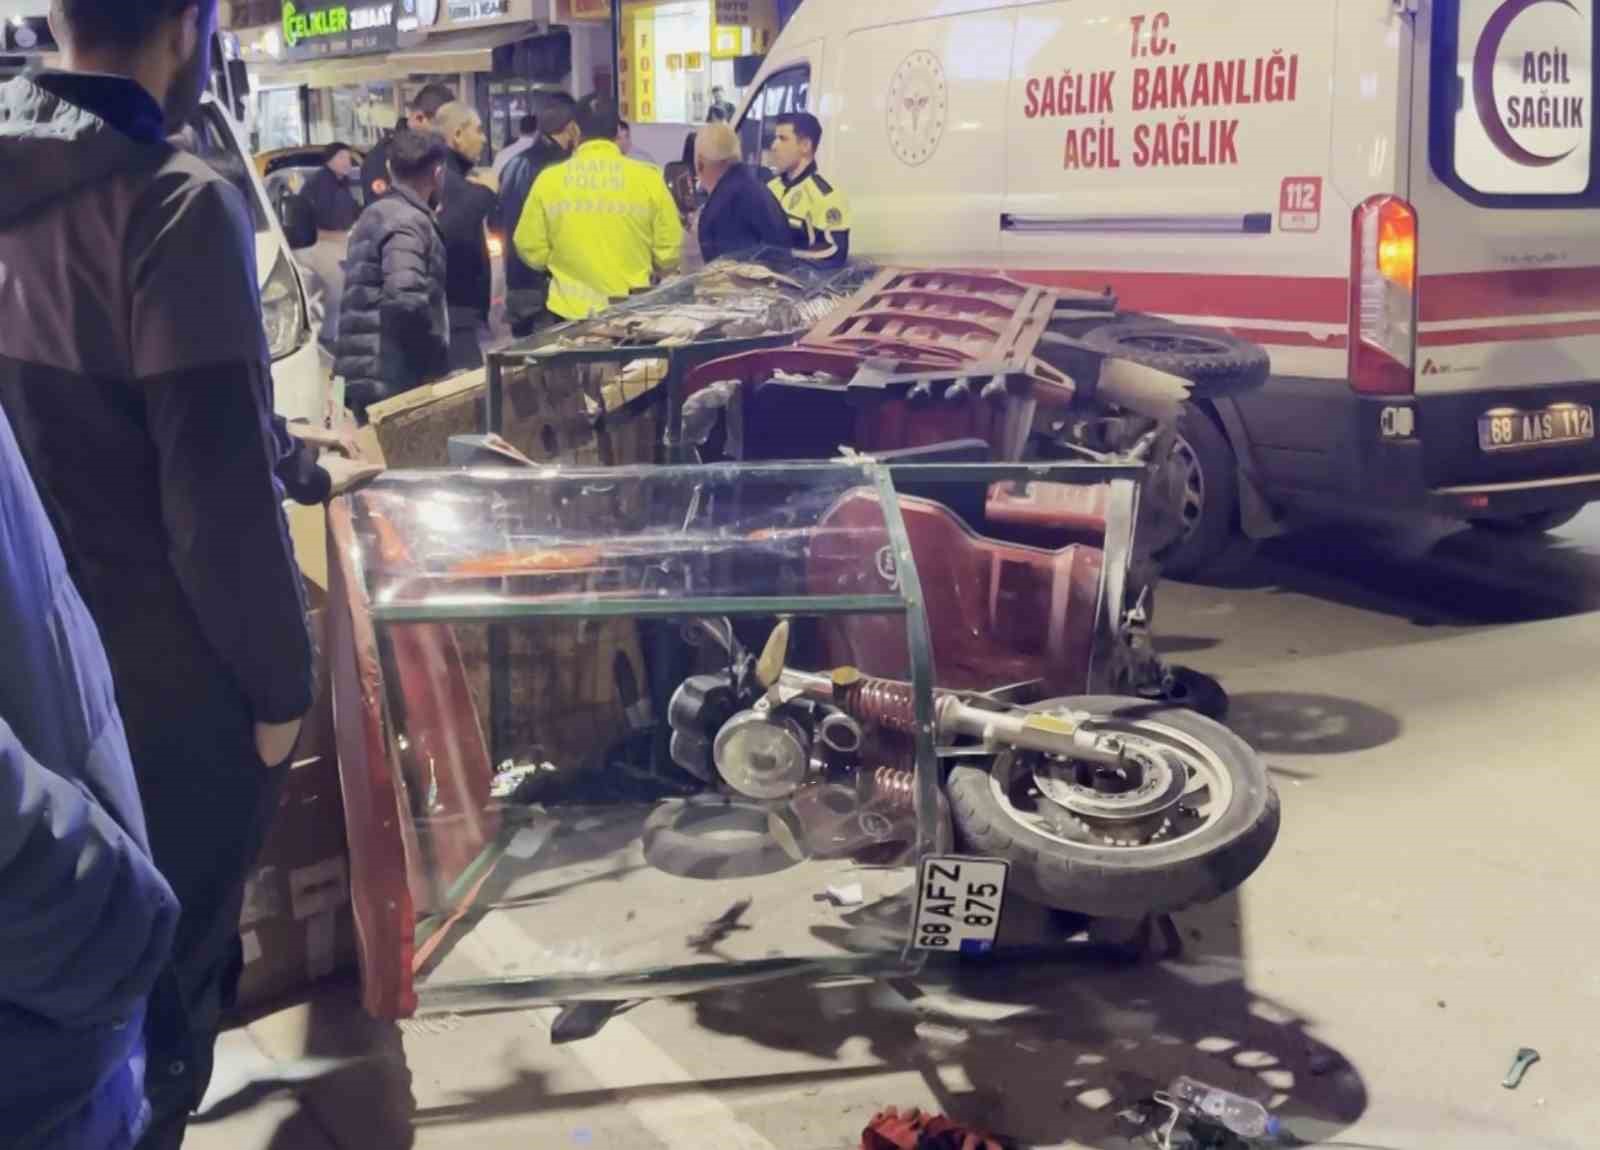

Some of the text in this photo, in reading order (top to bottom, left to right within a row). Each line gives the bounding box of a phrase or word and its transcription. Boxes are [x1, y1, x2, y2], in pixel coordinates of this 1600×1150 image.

[1130, 12, 1176, 57] T.C.
[640, 34, 650, 116] FOTO
[1024, 49, 1298, 118] SAĞLIK BAKANLIĞI
[1523, 46, 1571, 84] ACİL
[1507, 89, 1583, 128] SAĞLIK
[1064, 115, 1239, 170] ACİL SAĞLIK
[1287, 184, 1315, 209] 112
[1490, 407, 1589, 444] 68 AAS 112
[919, 863, 961, 947] 68 AFZ
[963, 882, 998, 927] 875
